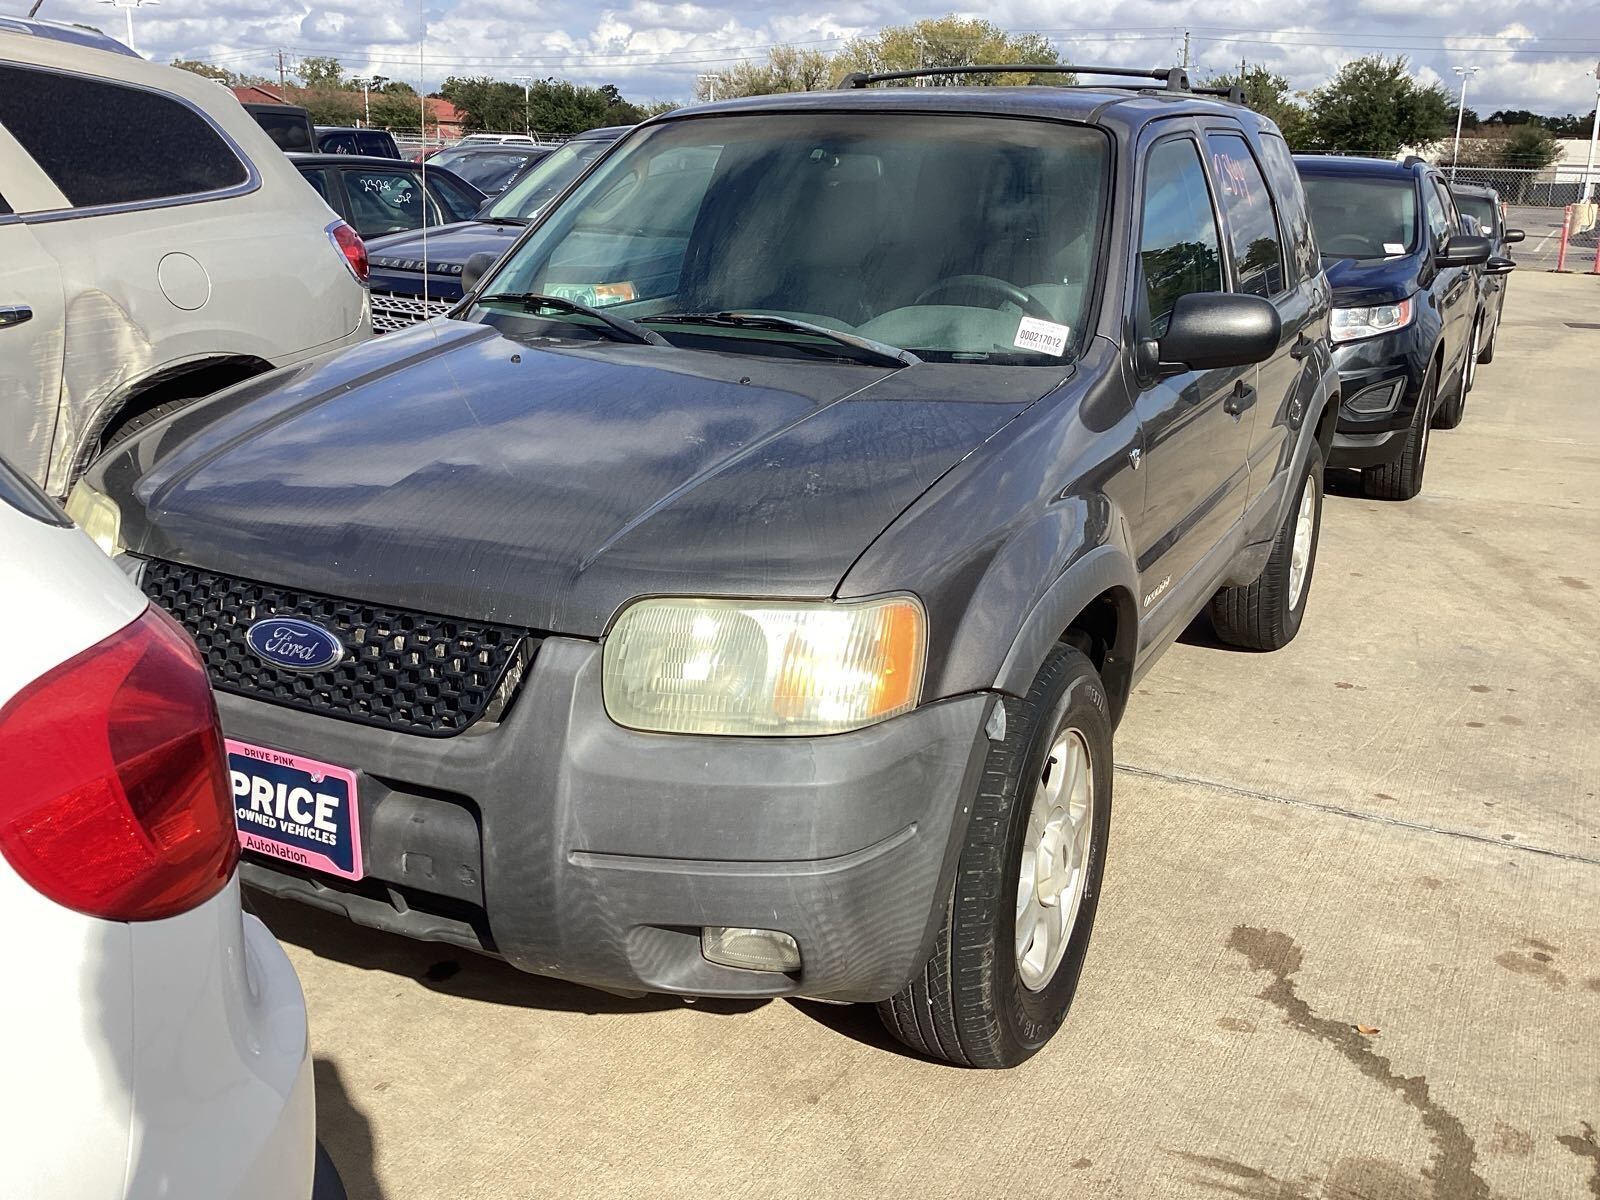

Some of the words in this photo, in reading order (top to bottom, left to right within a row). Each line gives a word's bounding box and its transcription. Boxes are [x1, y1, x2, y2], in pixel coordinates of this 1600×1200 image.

[379, 257, 426, 271] LAND
[1019, 329, 1062, 348] 000217012
[265, 626, 320, 660] Ford
[244, 747, 271, 761] DRIVE
[273, 754, 295, 767] PINK
[229, 769, 340, 833] PRICE
[235, 807, 277, 829] -OWNED
[279, 820, 337, 846] VEHICLES
[246, 836, 308, 864] AutoNation
